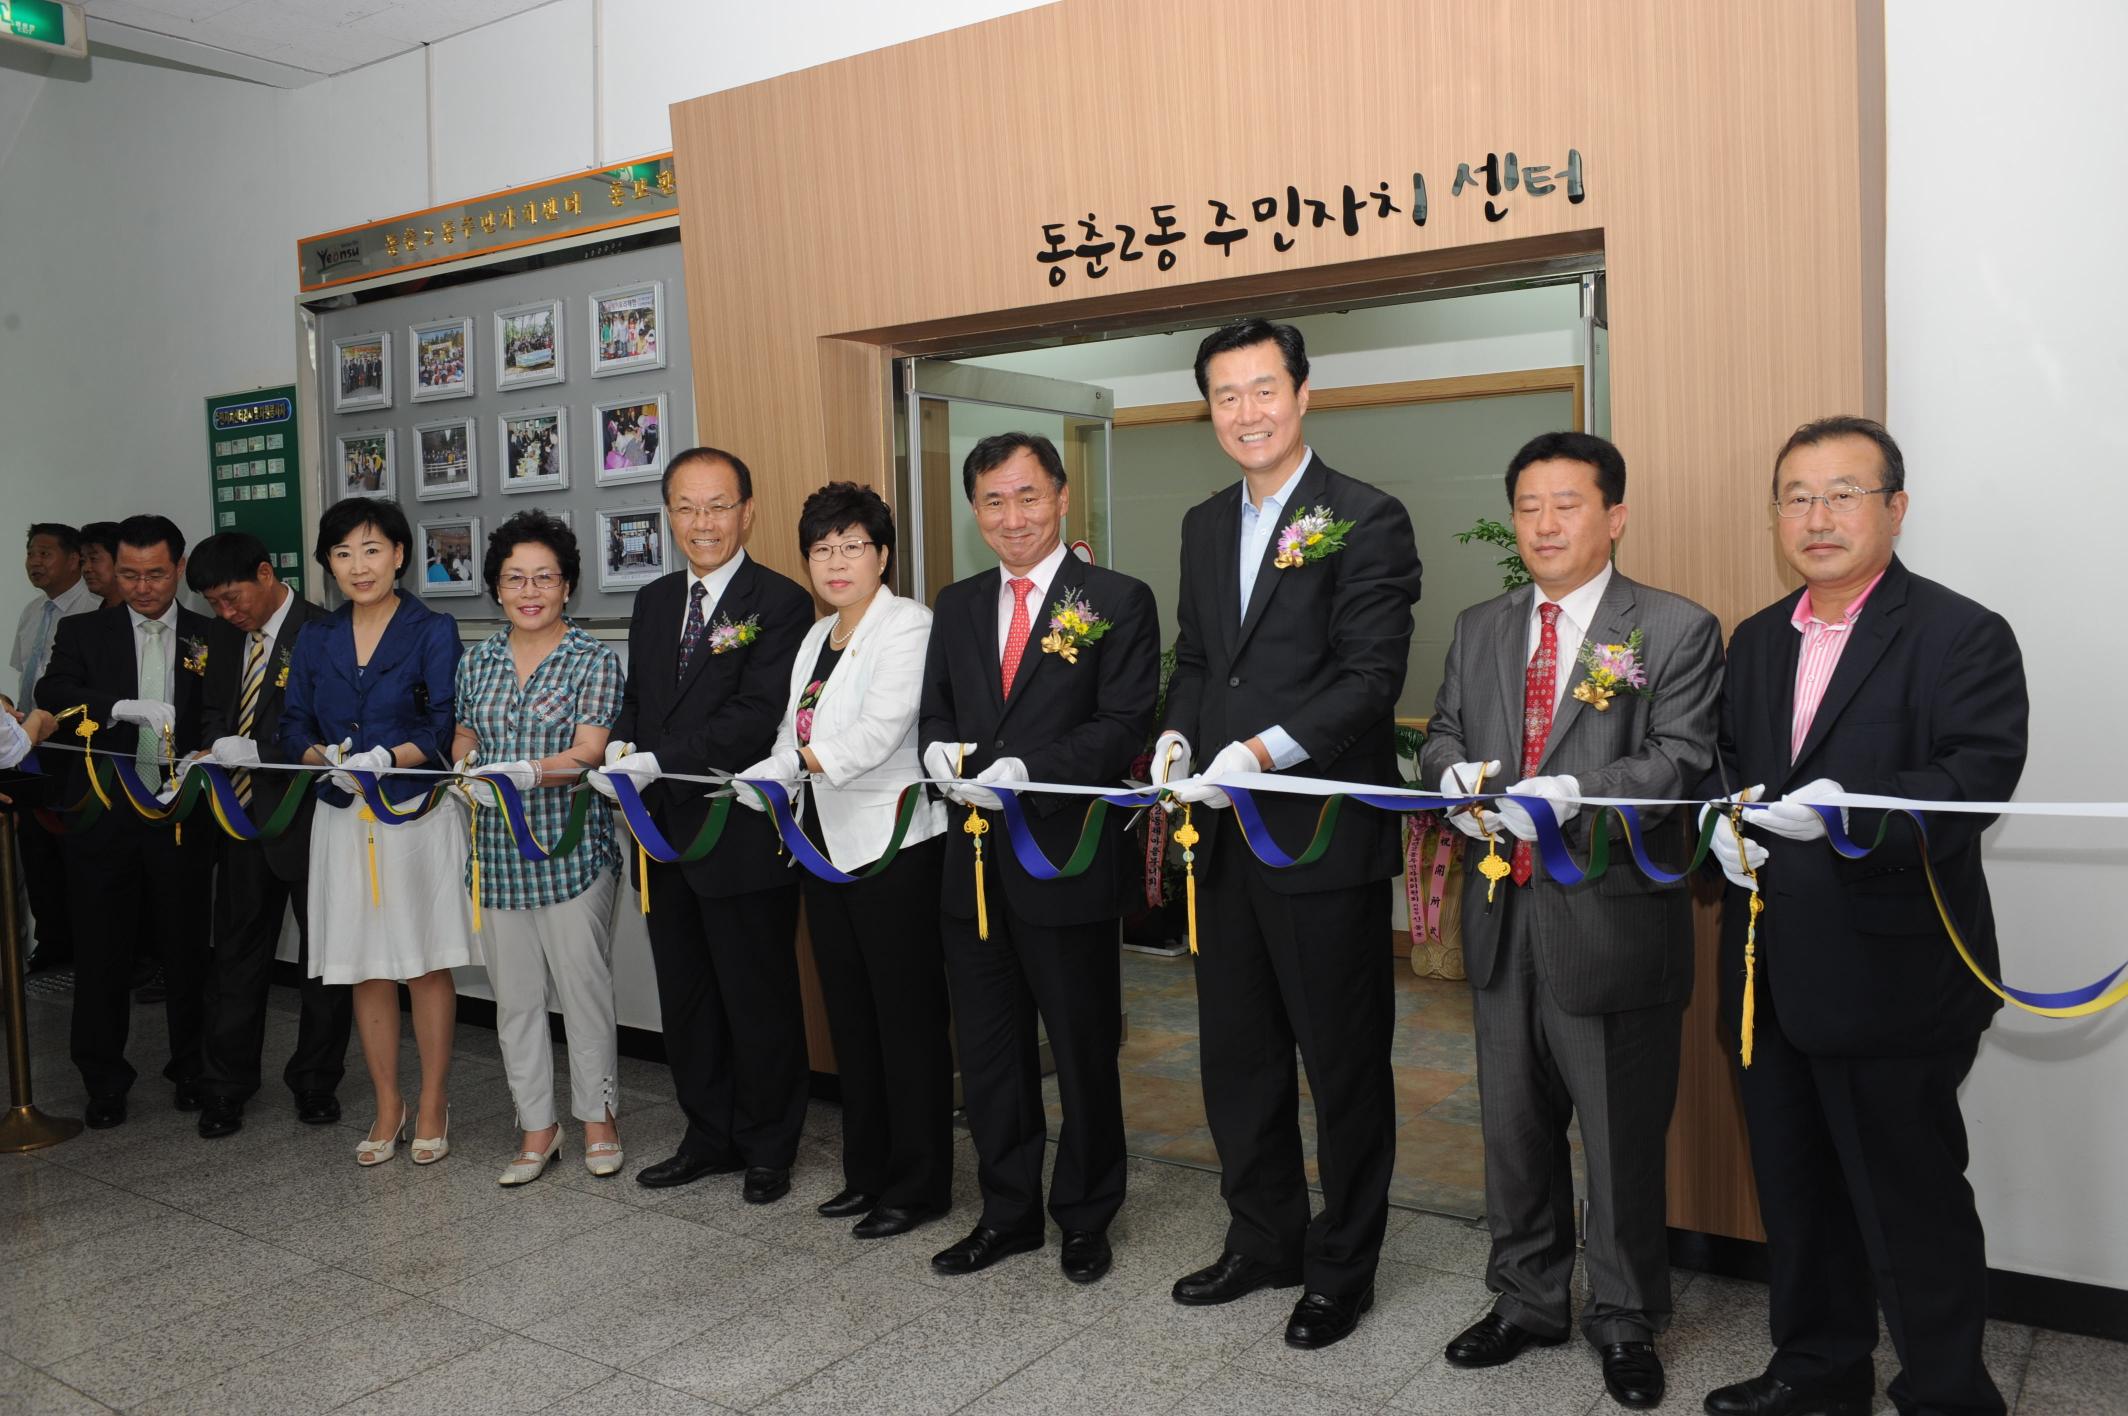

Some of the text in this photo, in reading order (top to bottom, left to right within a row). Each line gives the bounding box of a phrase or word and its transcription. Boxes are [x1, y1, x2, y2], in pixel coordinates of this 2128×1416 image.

[315, 246, 360, 270] Yeonsu
[1036, 148, 1586, 287] 동춘2동 주민자치 센터
